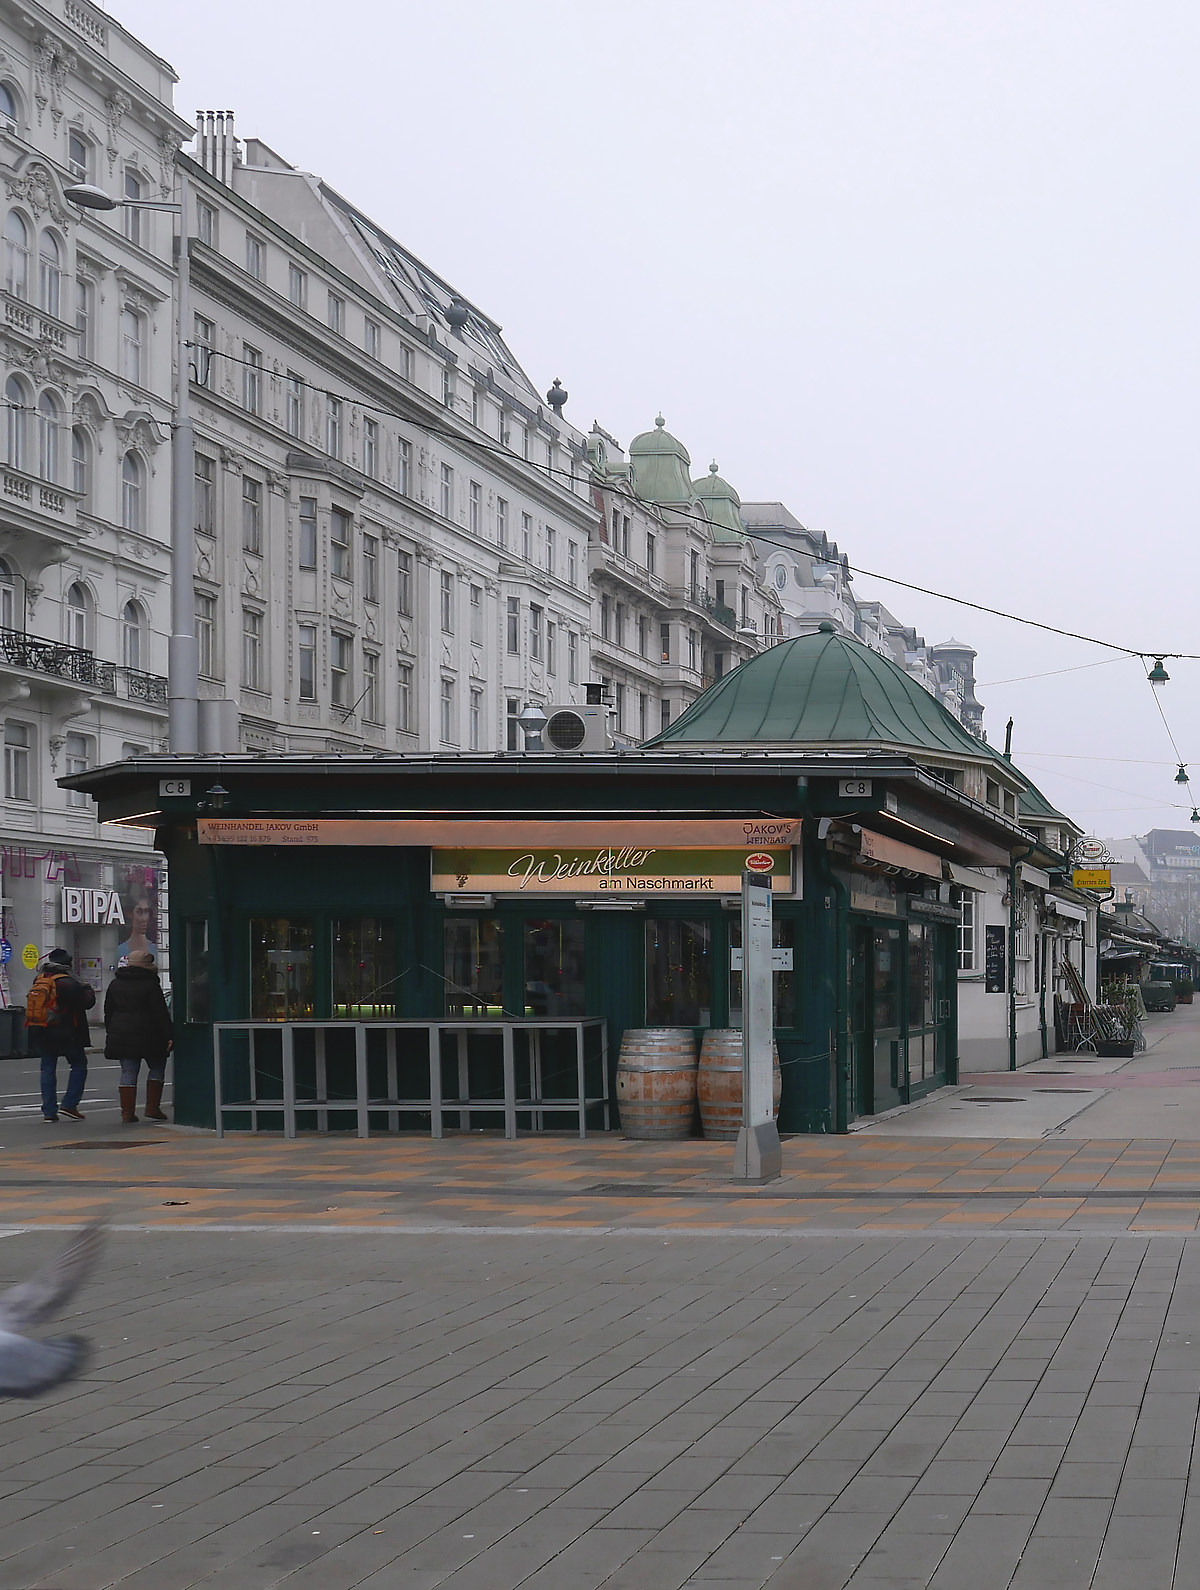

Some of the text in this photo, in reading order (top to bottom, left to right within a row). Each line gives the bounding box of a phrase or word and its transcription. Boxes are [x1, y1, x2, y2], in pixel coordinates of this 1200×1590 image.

[165, 783, 185, 794] C 8
[845, 783, 866, 794] C 8
[207, 823, 264, 831] WEINHANDEL
[266, 823, 292, 832] JAKOV
[743, 822, 792, 835] JAKOV'S
[746, 835, 787, 845] WEINBAR
[507, 845, 657, 889] Weinkeller
[599, 877, 714, 890] am Naschmarkt
[62, 888, 126, 925] BIPA
